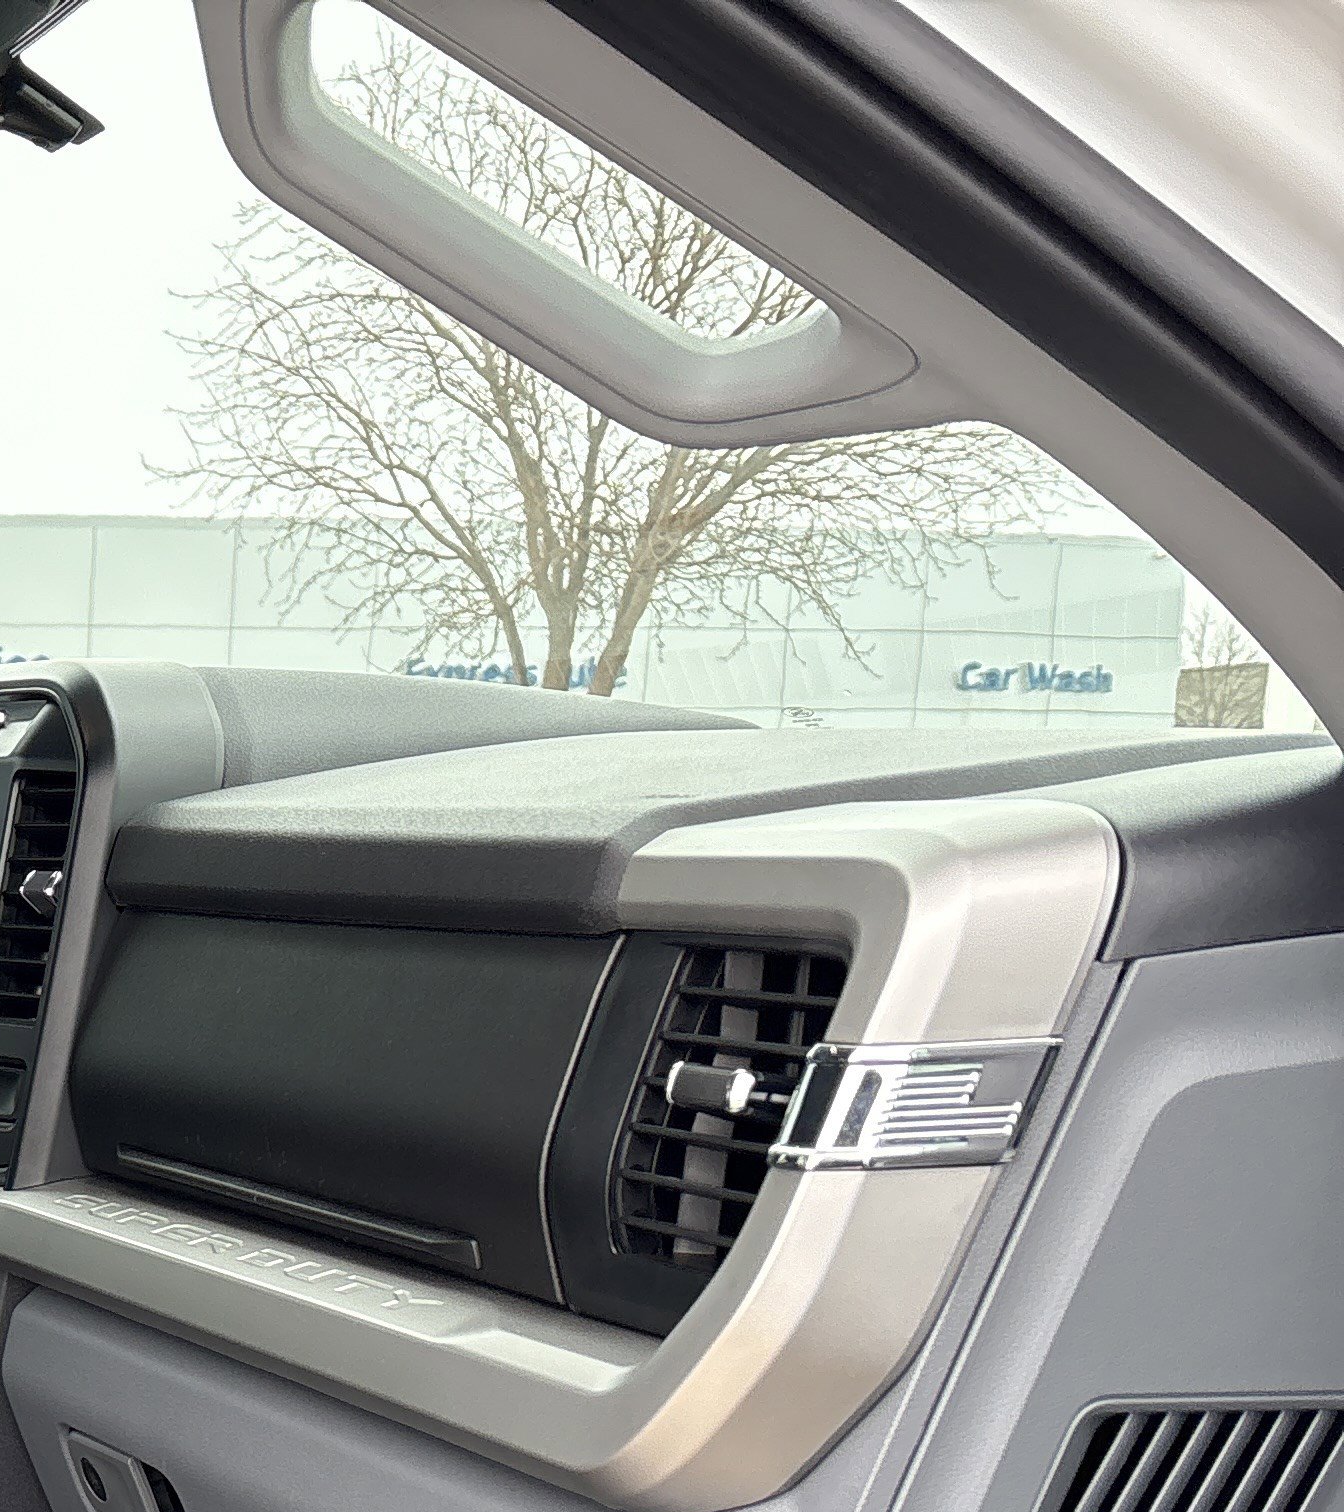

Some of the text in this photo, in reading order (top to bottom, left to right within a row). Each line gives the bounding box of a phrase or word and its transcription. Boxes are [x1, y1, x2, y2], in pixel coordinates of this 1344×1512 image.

[955, 660, 1113, 693] Car Wash
[54, 1194, 445, 1311] SUPER DUTY
